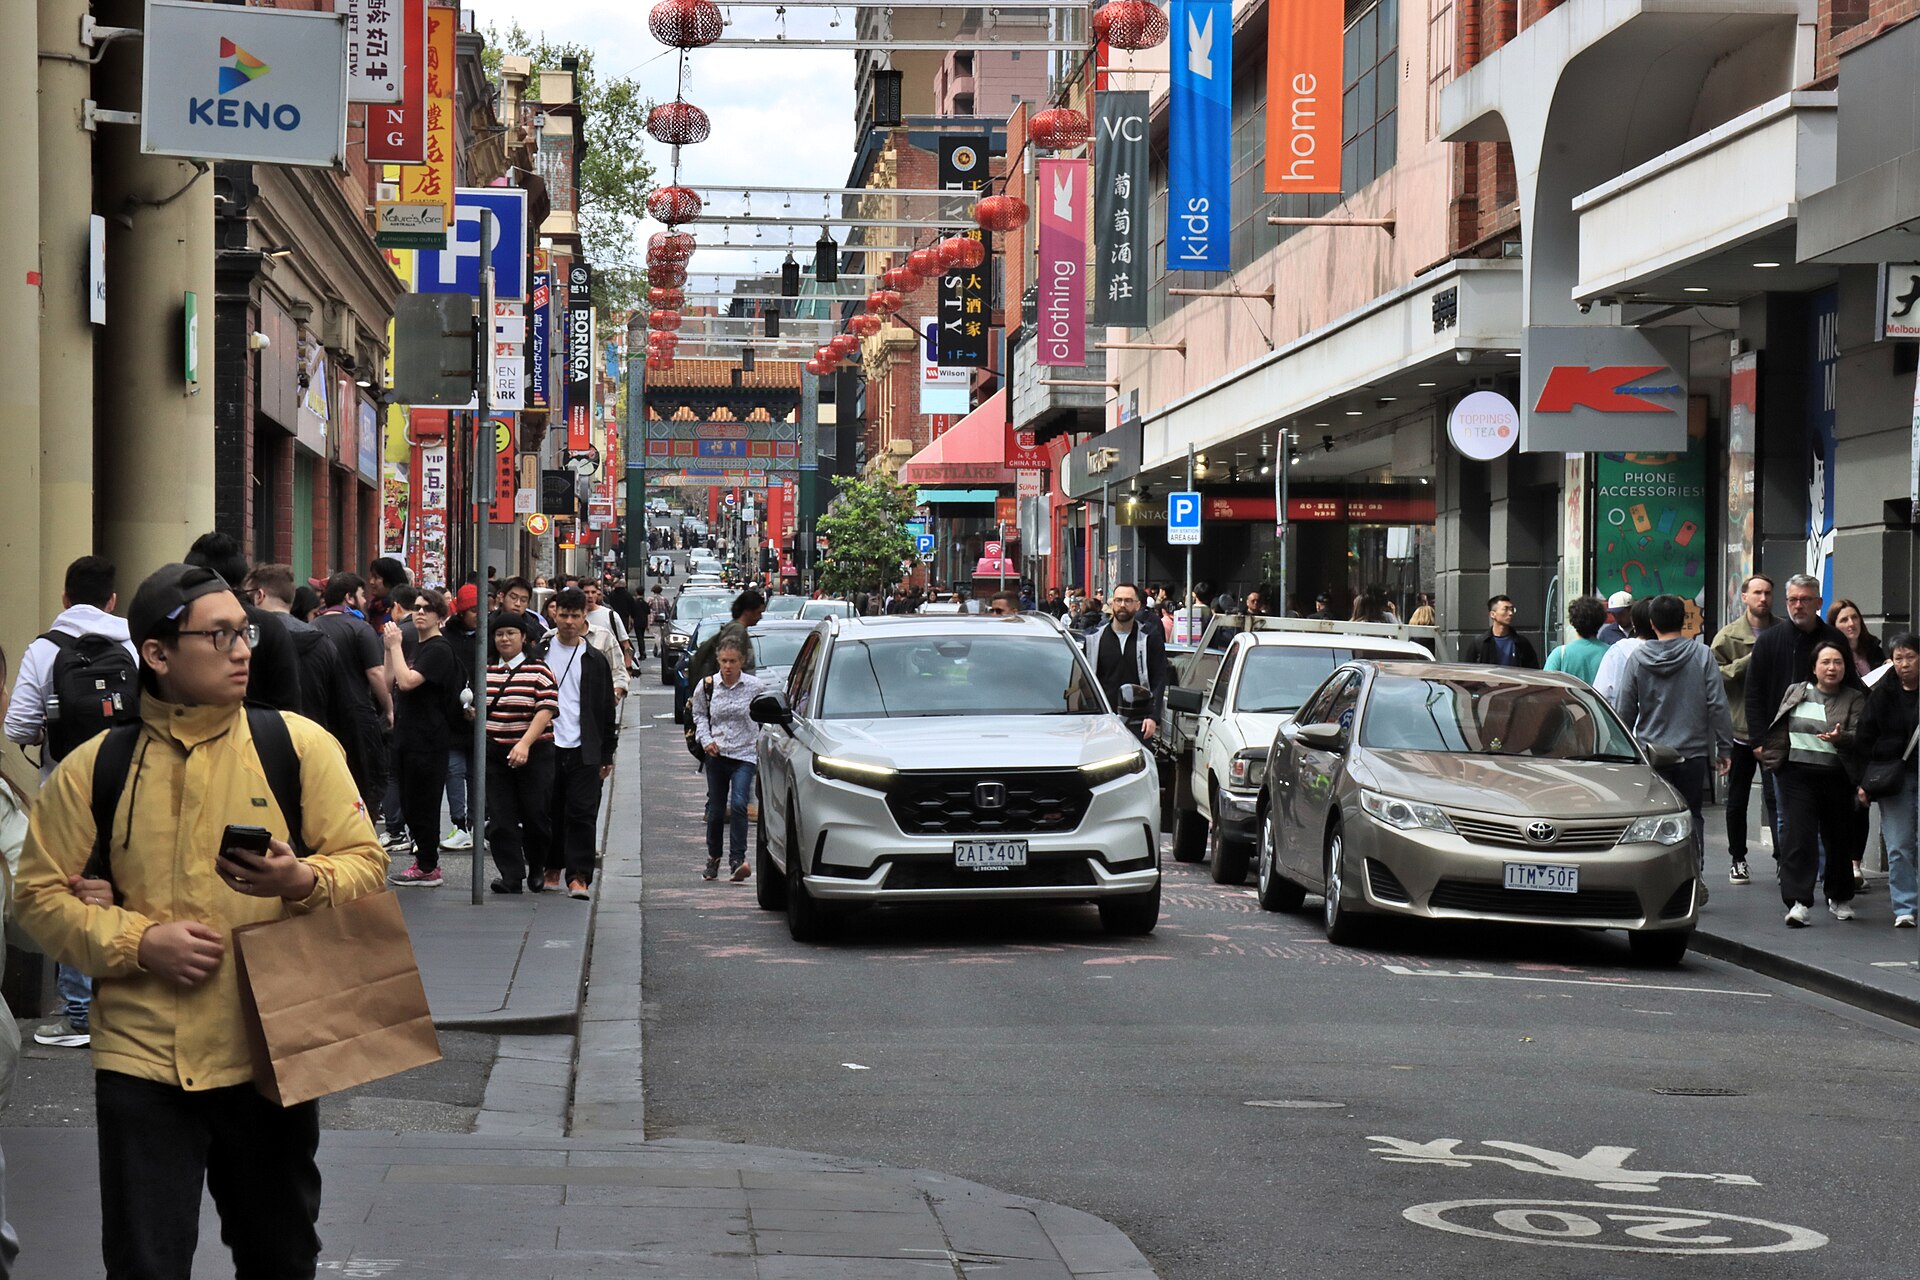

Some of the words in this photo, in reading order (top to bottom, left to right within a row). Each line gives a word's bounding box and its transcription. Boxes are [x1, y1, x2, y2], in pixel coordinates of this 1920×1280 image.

[349, 43, 358, 76] COW
[189, 97, 301, 131] KENO
[1103, 116, 1143, 142] VC
[1282, 73, 1317, 180] home
[1109, 173, 1133, 301] 葡萄酒莊
[1180, 197, 1210, 260] kids
[1048, 260, 1076, 359] clothing
[575, 310, 589, 382] BORNGA
[495, 367, 516, 377] EN
[1459, 413, 1512, 425] TOPPINGS
[1474, 427, 1496, 438] TEA
[426, 455, 444, 463] VIP
[912, 465, 997, 480] WESTLAKE
[1625, 472, 1676, 483] PHONE
[1599, 485, 1705, 498] ACCESSORIES!
[1176, 499, 1193, 523] P
[920, 538, 930, 552] P
[957, 846, 984, 862] 2AI
[1509, 867, 1536, 885] 1TM
[1548, 869, 1576, 887] 50F
